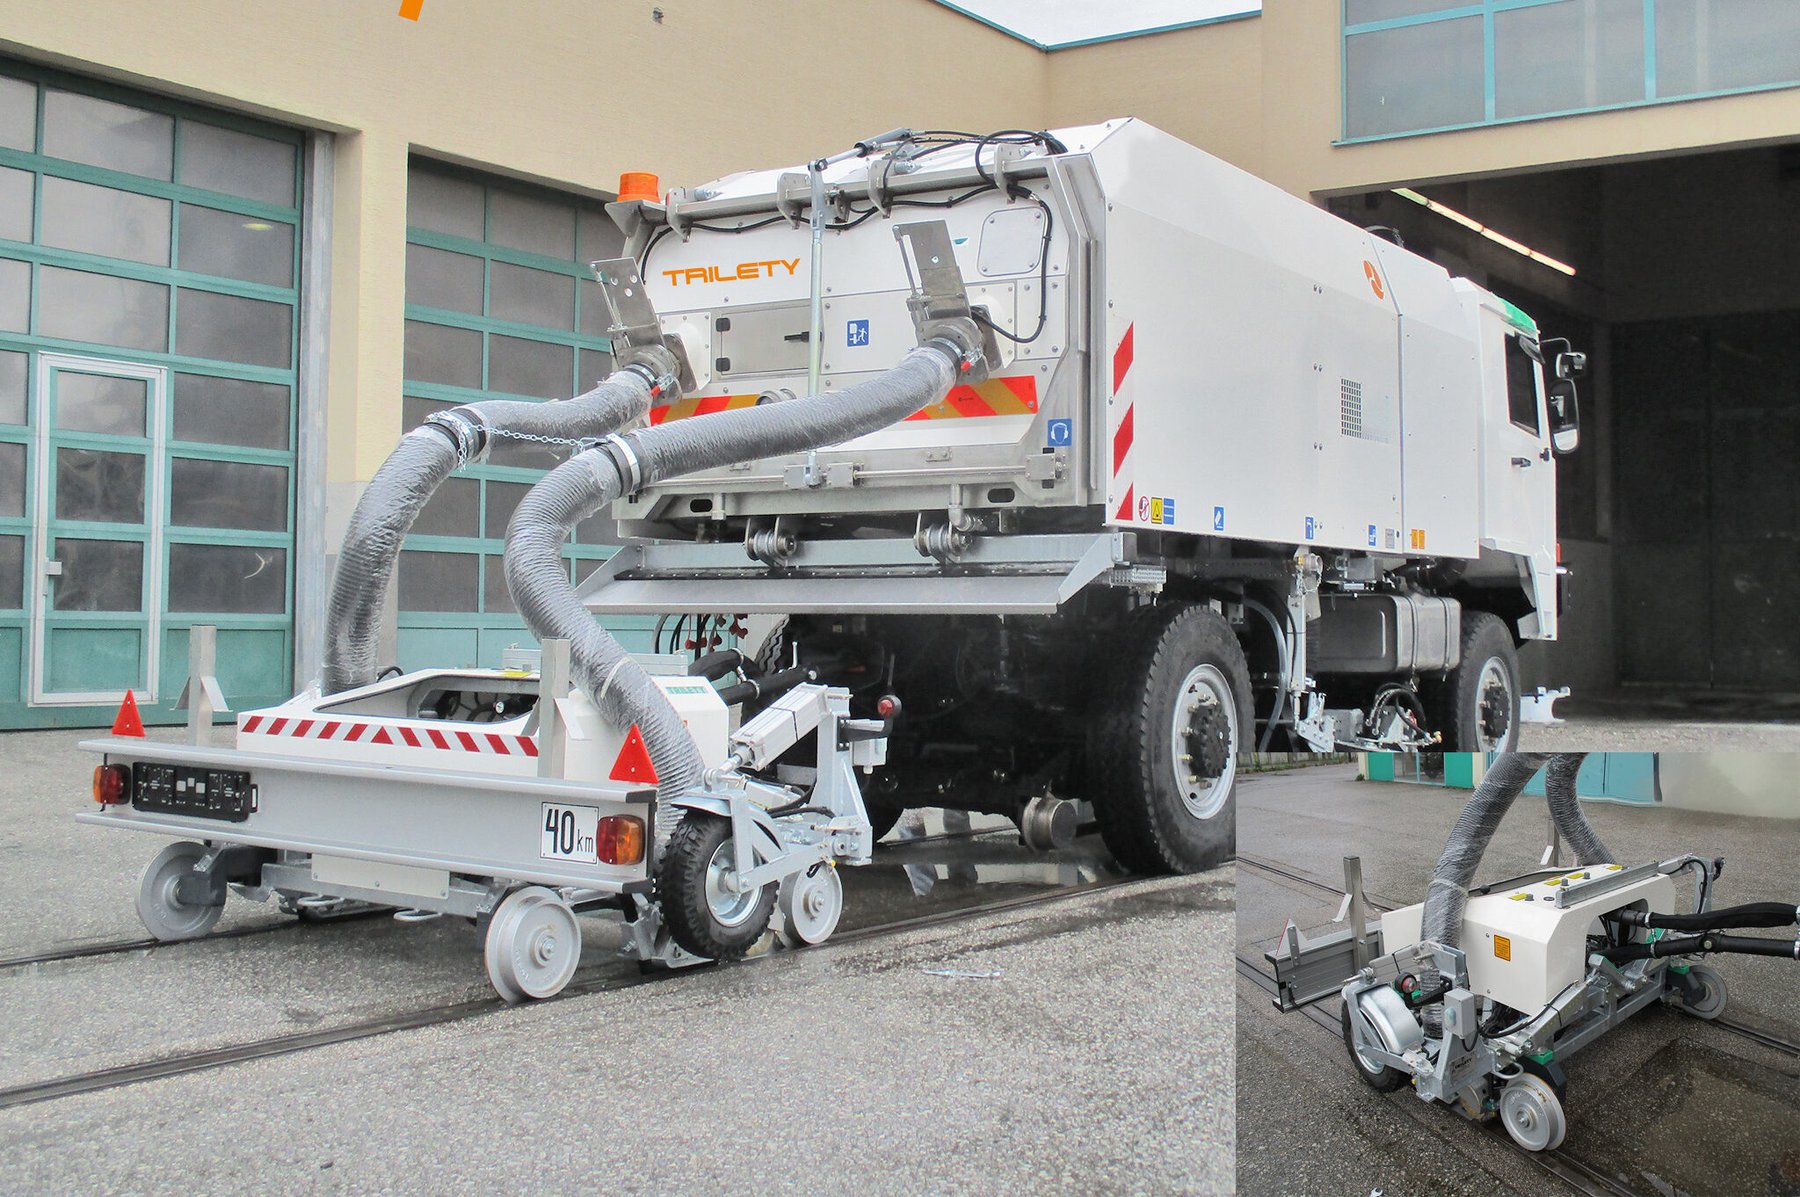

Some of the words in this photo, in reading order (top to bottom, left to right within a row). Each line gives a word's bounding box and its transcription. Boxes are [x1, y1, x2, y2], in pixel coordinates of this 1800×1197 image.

[662, 258, 800, 286] TRILETY
[545, 808, 575, 854] 40
[576, 828, 594, 853] km
